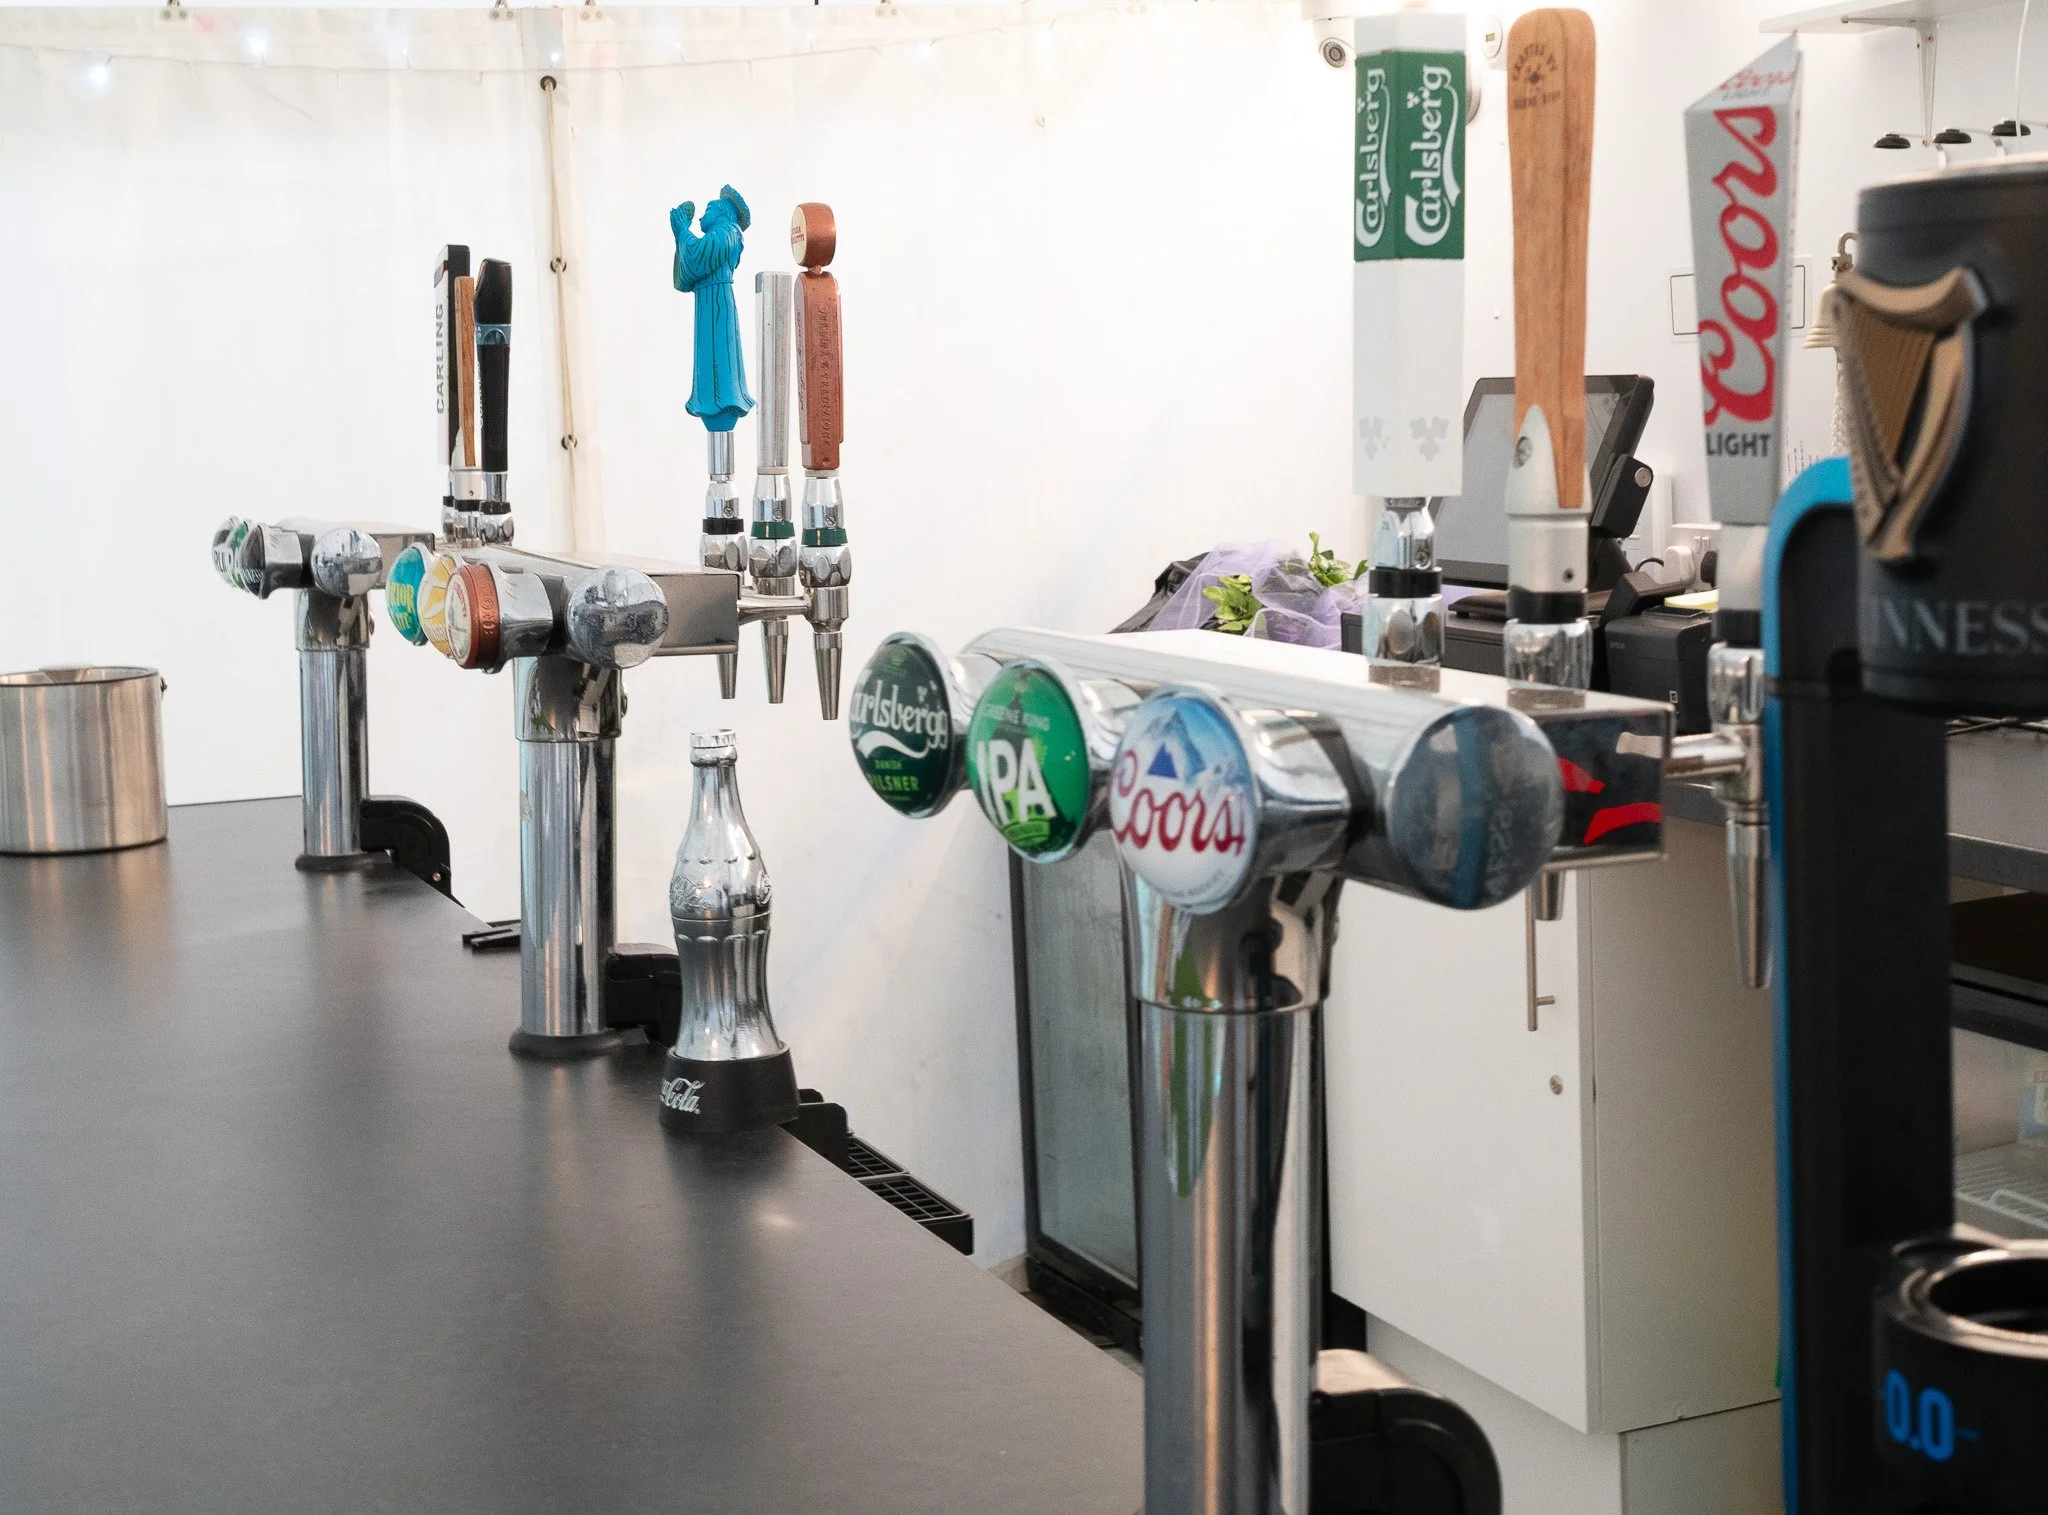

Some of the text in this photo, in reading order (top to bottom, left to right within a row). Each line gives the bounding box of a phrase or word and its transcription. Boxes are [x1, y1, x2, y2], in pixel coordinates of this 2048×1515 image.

[1356, 67, 1391, 248] Carlsberg
[1405, 64, 1461, 247] Carlsberg
[1698, 106, 1779, 427] Coors
[436, 303, 444, 414] CARLING
[1705, 432, 1771, 457] LIGHT
[976, 736, 1058, 826] IPA
[1110, 748, 1245, 856] Coors
[1884, 1368, 1955, 1462] 0.0
